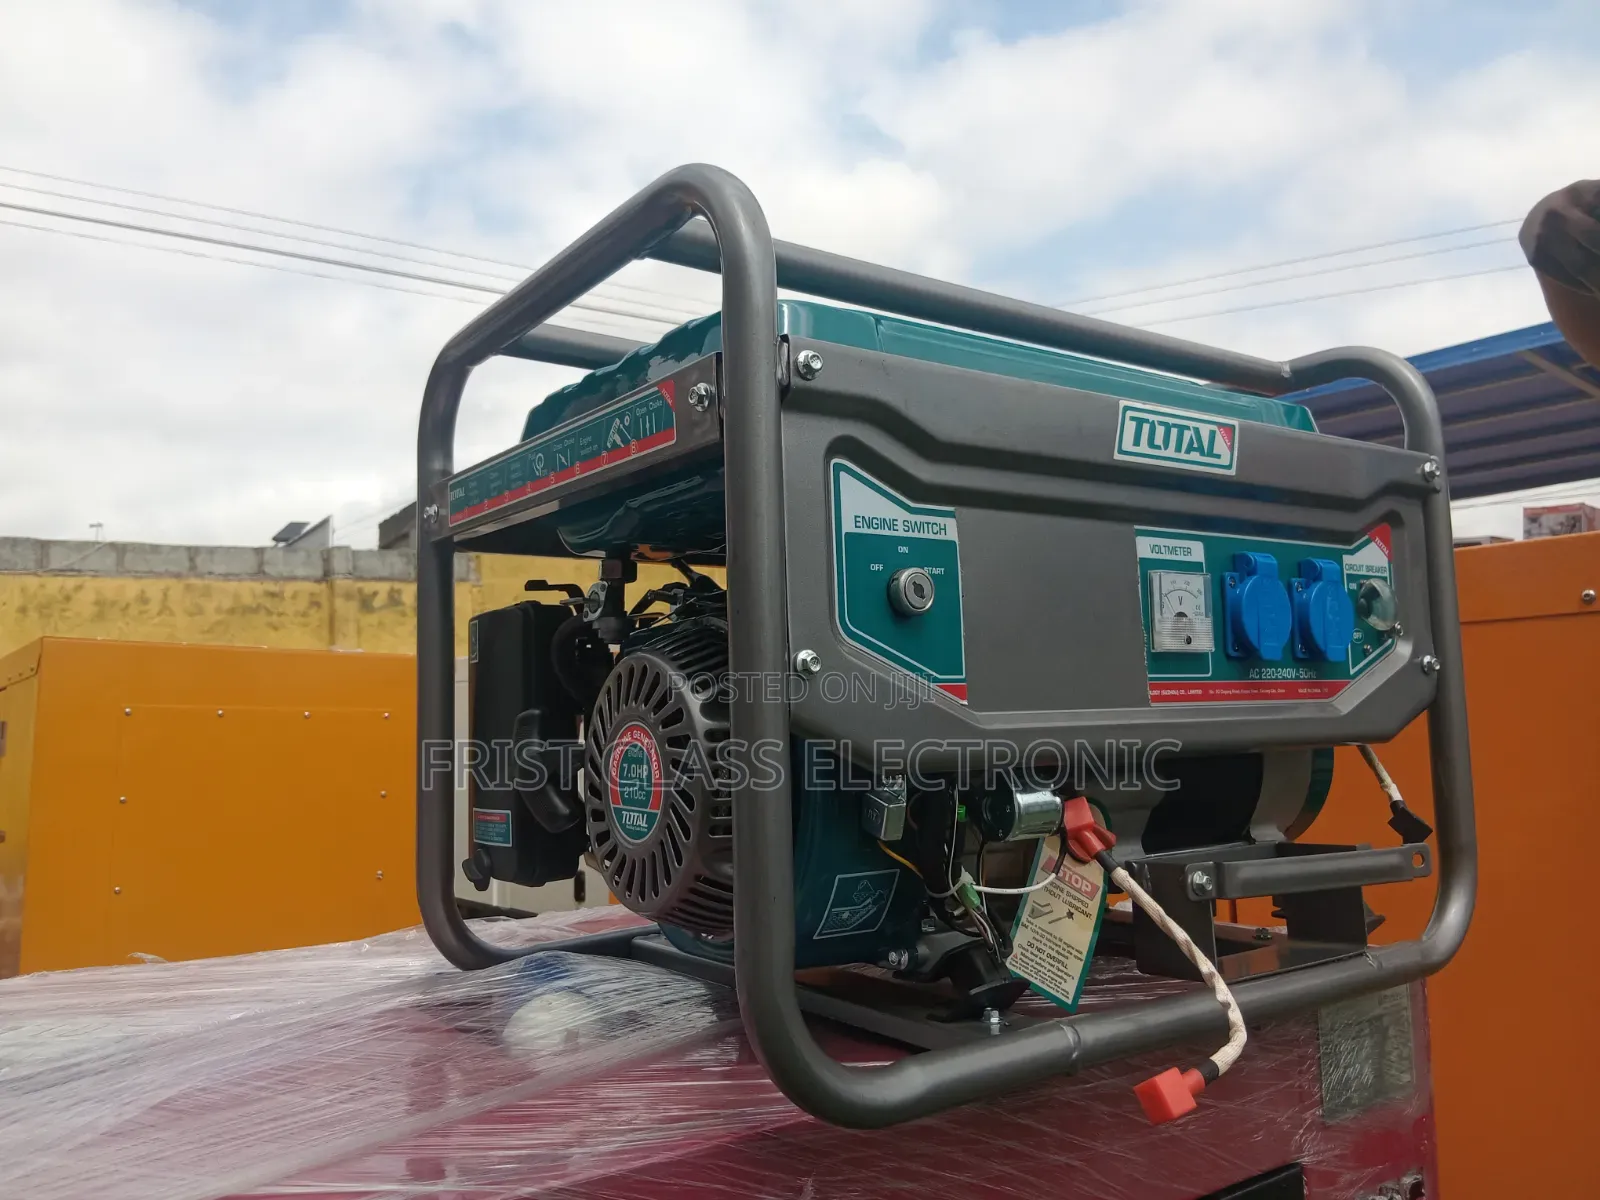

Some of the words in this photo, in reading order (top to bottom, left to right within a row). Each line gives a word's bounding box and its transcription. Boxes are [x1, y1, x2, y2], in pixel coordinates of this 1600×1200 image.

[1128, 416, 1222, 460] TOTAL
[854, 514, 899, 532] ENGINE
[902, 519, 947, 536] SWITCH
[898, 546, 909, 554] ON
[1149, 544, 1192, 557] VOLTMETER
[924, 567, 944, 575] START
[1344, 563, 1364, 572] CIRCUIT
[1365, 564, 1388, 574] BREAKER
[1178, 595, 1183, 606] V
[1352, 632, 1362, 640] OFF
[1249, 668, 1260, 678] AC
[632, 730, 660, 778] GENERATOR
[622, 764, 649, 779] 7.0HP
[622, 810, 648, 828] TOTAL
[1058, 867, 1092, 894] STOP
[1066, 890, 1088, 908] SHIPPED
[1035, 946, 1045, 955] NOT
